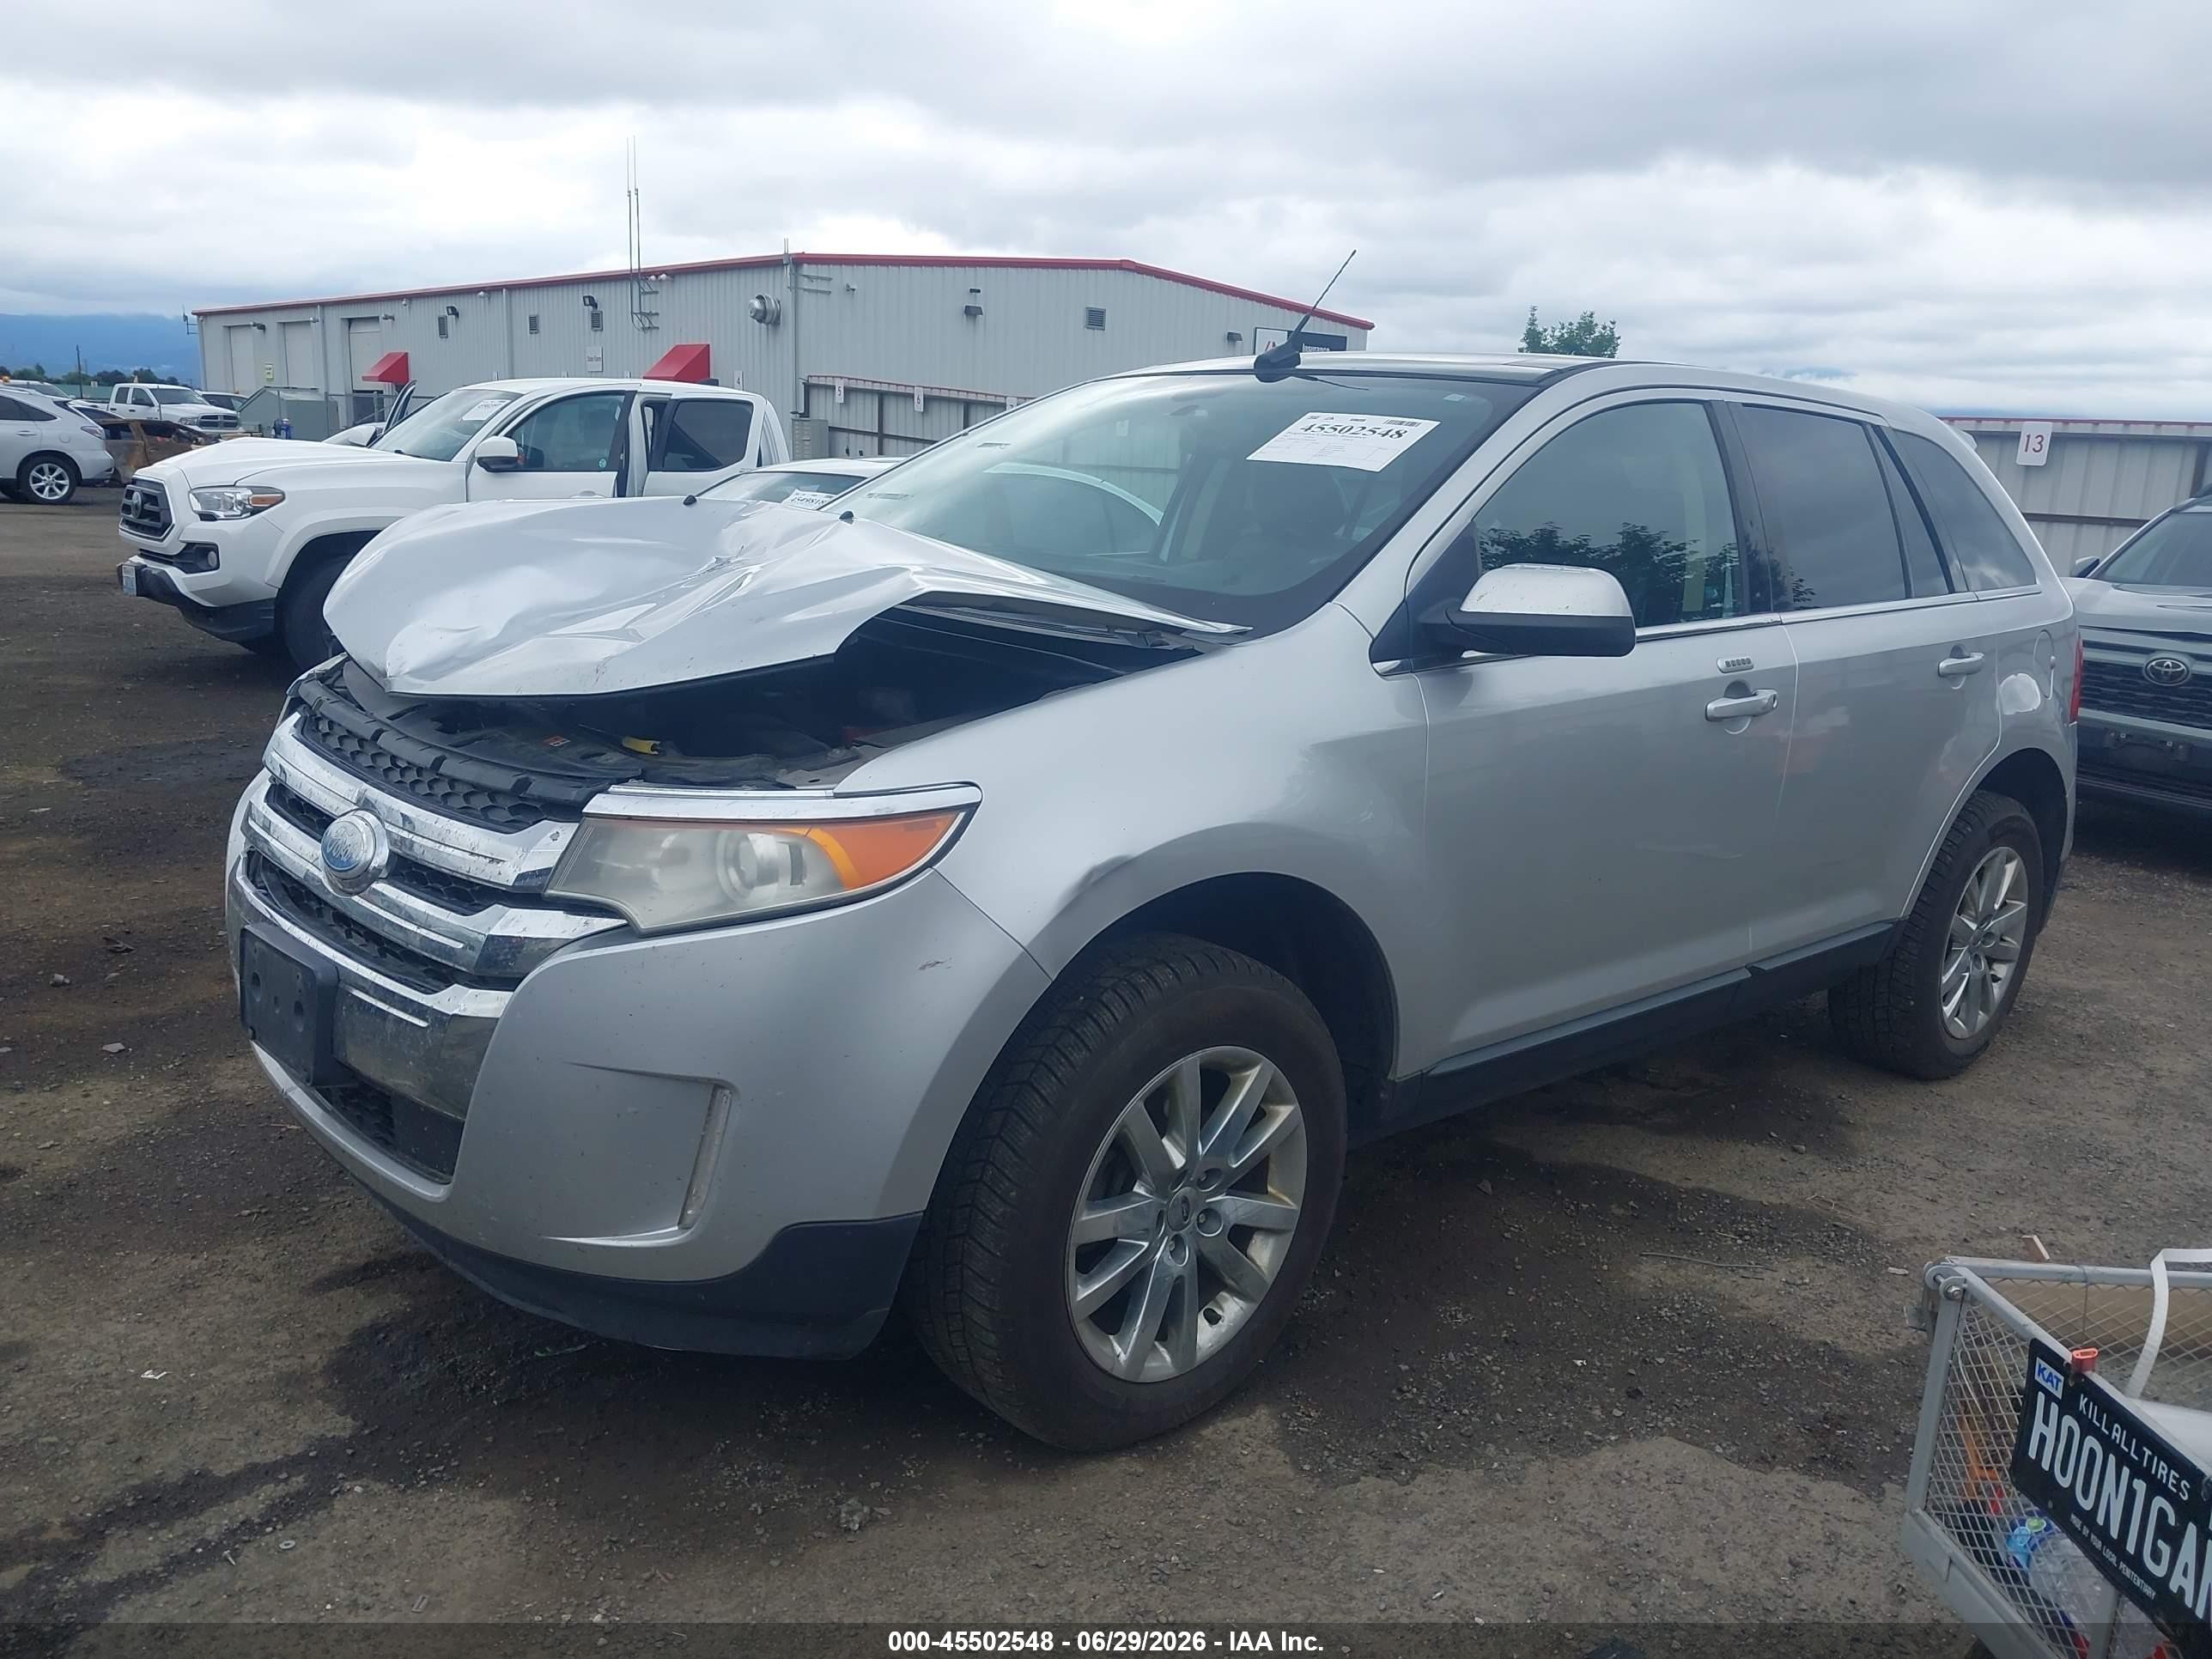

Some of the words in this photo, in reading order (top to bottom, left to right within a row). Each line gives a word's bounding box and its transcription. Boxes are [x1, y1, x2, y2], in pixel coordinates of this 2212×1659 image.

[837, 386, 842, 397] 5
[916, 395, 921, 404] 6
[1300, 423, 1408, 439] 45502548
[2024, 434, 2045, 453] 13
[2038, 1363, 2063, 1392] KAT
[2079, 1394, 2109, 1435] KILL
[2112, 1423, 2139, 1461] ALL
[2142, 1446, 2191, 1501] TIRES
